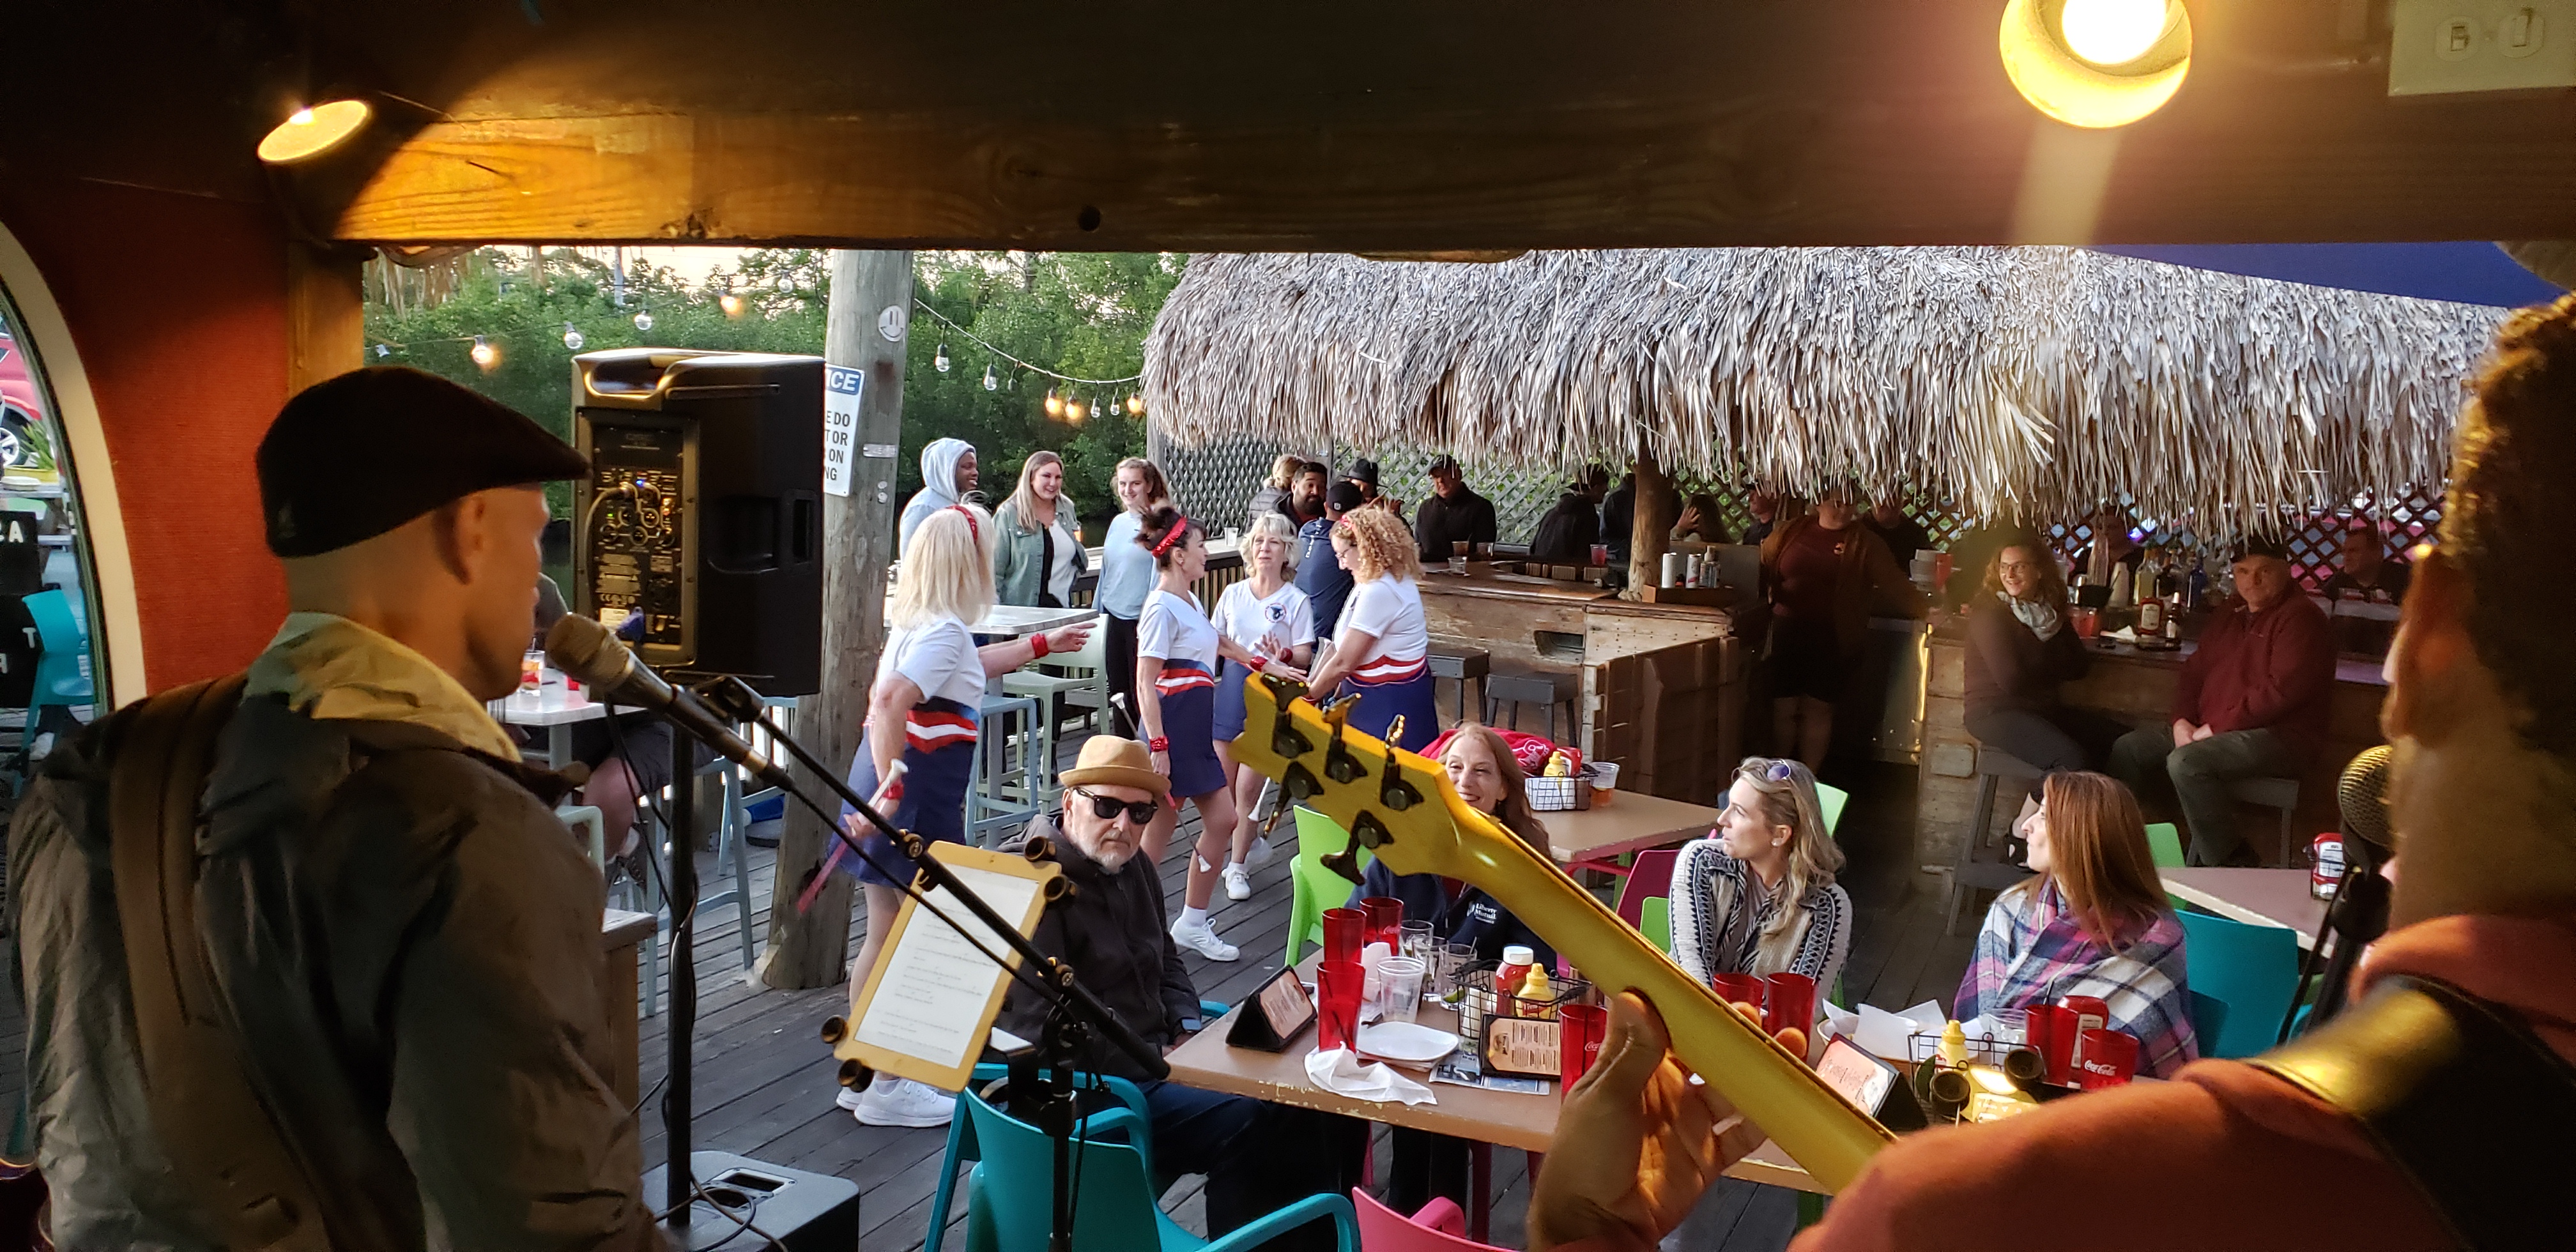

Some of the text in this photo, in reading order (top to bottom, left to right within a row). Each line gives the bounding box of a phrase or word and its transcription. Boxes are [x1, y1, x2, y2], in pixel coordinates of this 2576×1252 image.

[834, 412, 850, 427] DO
[832, 431, 848, 447] OR
[829, 448, 844, 464] ON
[0, 520, 24, 543] A
[22, 627, 36, 648] T
[1476, 903, 1498, 913] Liberty
